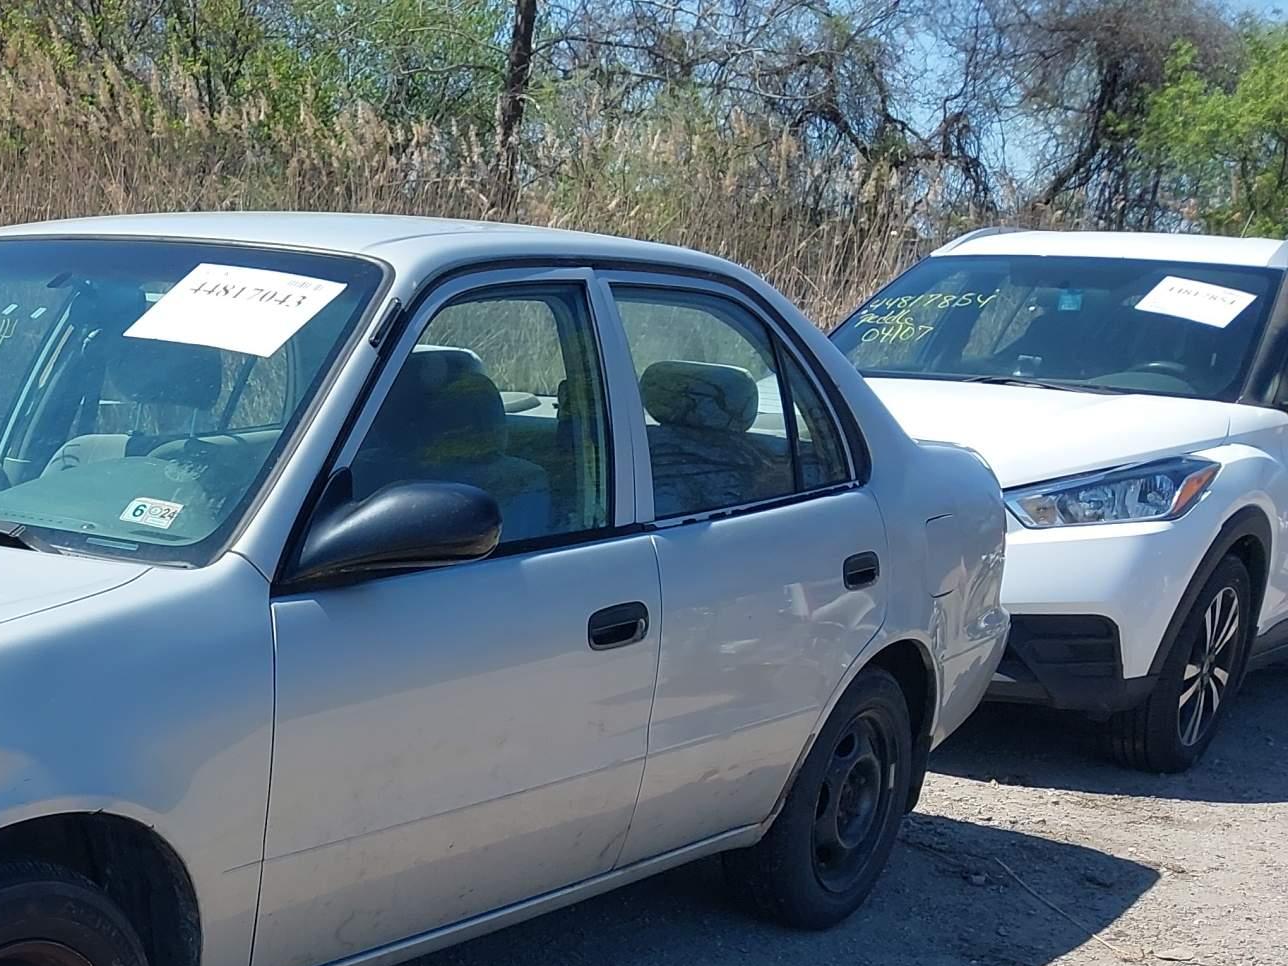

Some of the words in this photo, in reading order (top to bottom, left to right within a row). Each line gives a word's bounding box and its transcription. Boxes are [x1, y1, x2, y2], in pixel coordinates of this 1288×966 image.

[190, 282, 307, 308] 44817043
[869, 293, 997, 310] 44817854
[132, 504, 148, 517] 6
